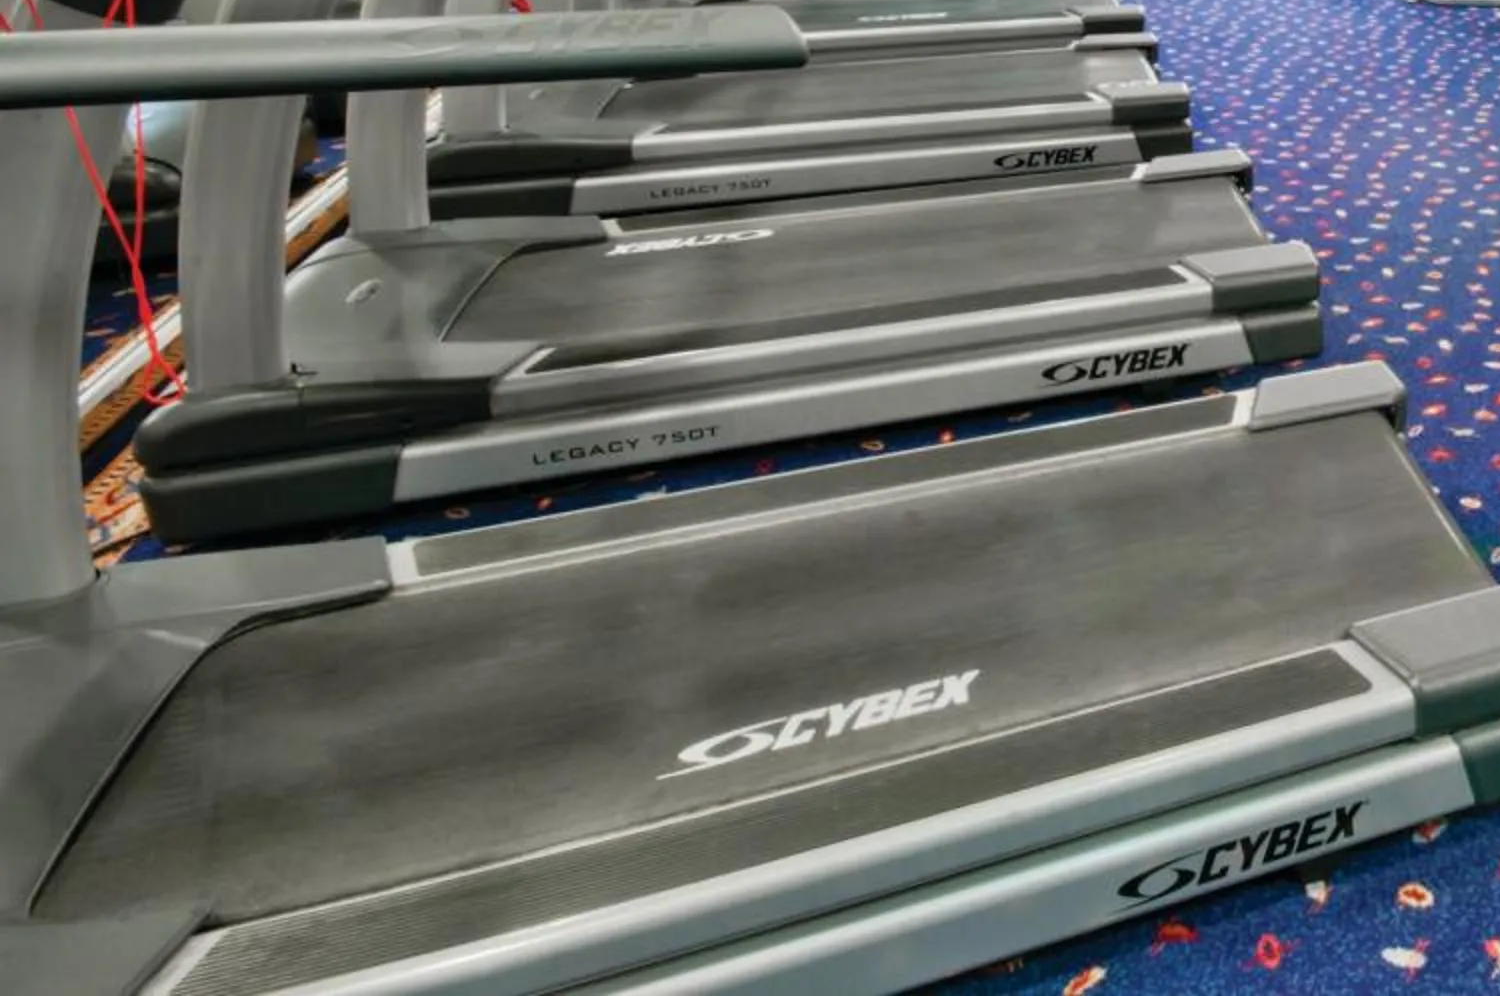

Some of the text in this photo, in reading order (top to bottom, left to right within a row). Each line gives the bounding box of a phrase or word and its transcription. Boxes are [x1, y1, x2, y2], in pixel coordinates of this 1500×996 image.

[1026, 145, 1098, 167] CYBEX
[1087, 343, 1189, 380] CYBEX
[532, 426, 721, 466] LEGACY 750T
[771, 669, 981, 751] CYBEX
[1197, 800, 1364, 886] CYBEX
